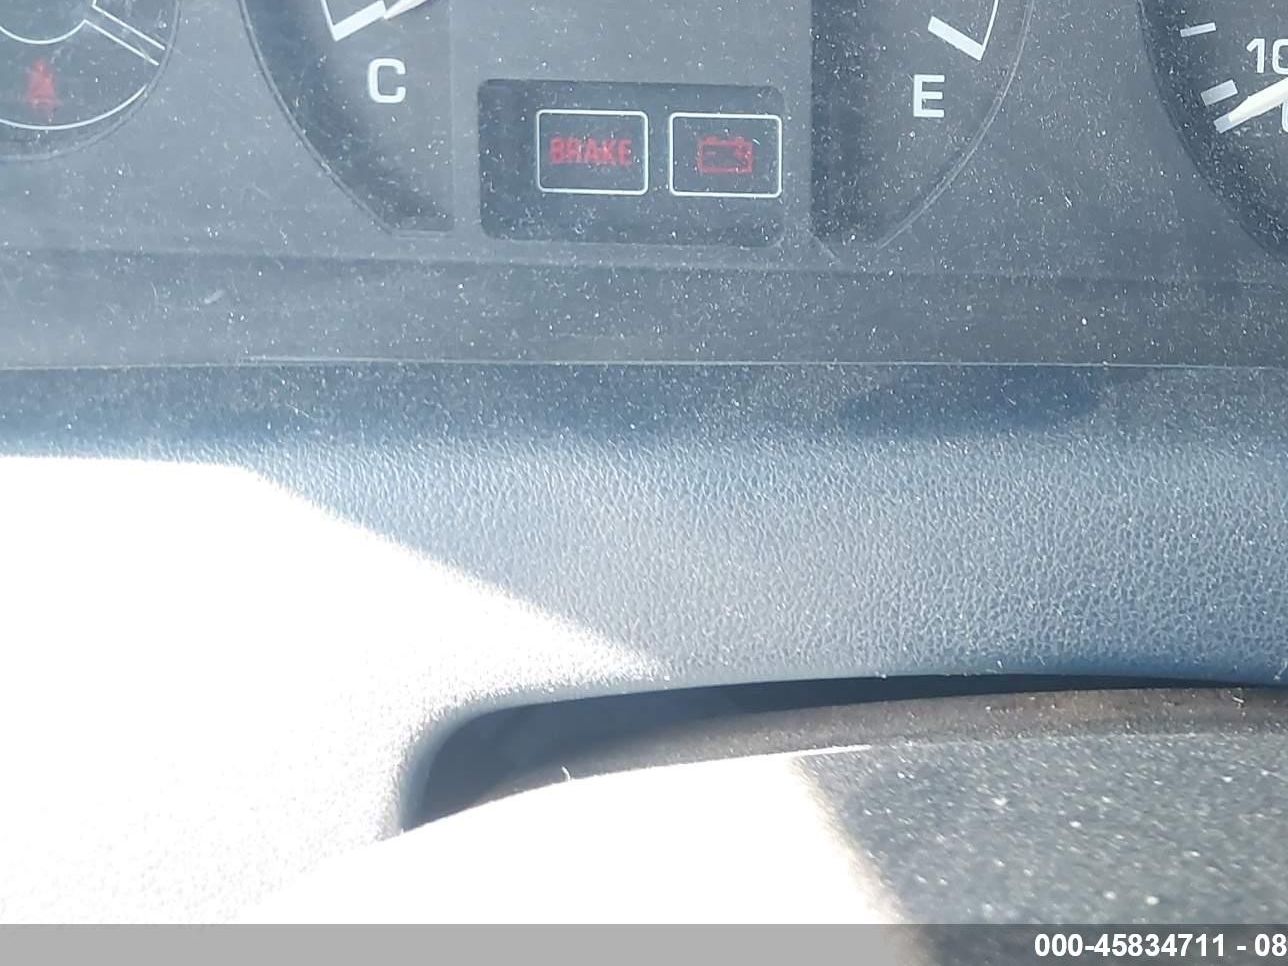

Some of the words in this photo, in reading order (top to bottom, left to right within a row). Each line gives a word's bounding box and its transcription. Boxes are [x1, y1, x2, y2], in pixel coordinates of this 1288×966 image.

[368, 58, 406, 105] C
[912, 74, 946, 118] E
[549, 136, 632, 166] BRAKE
